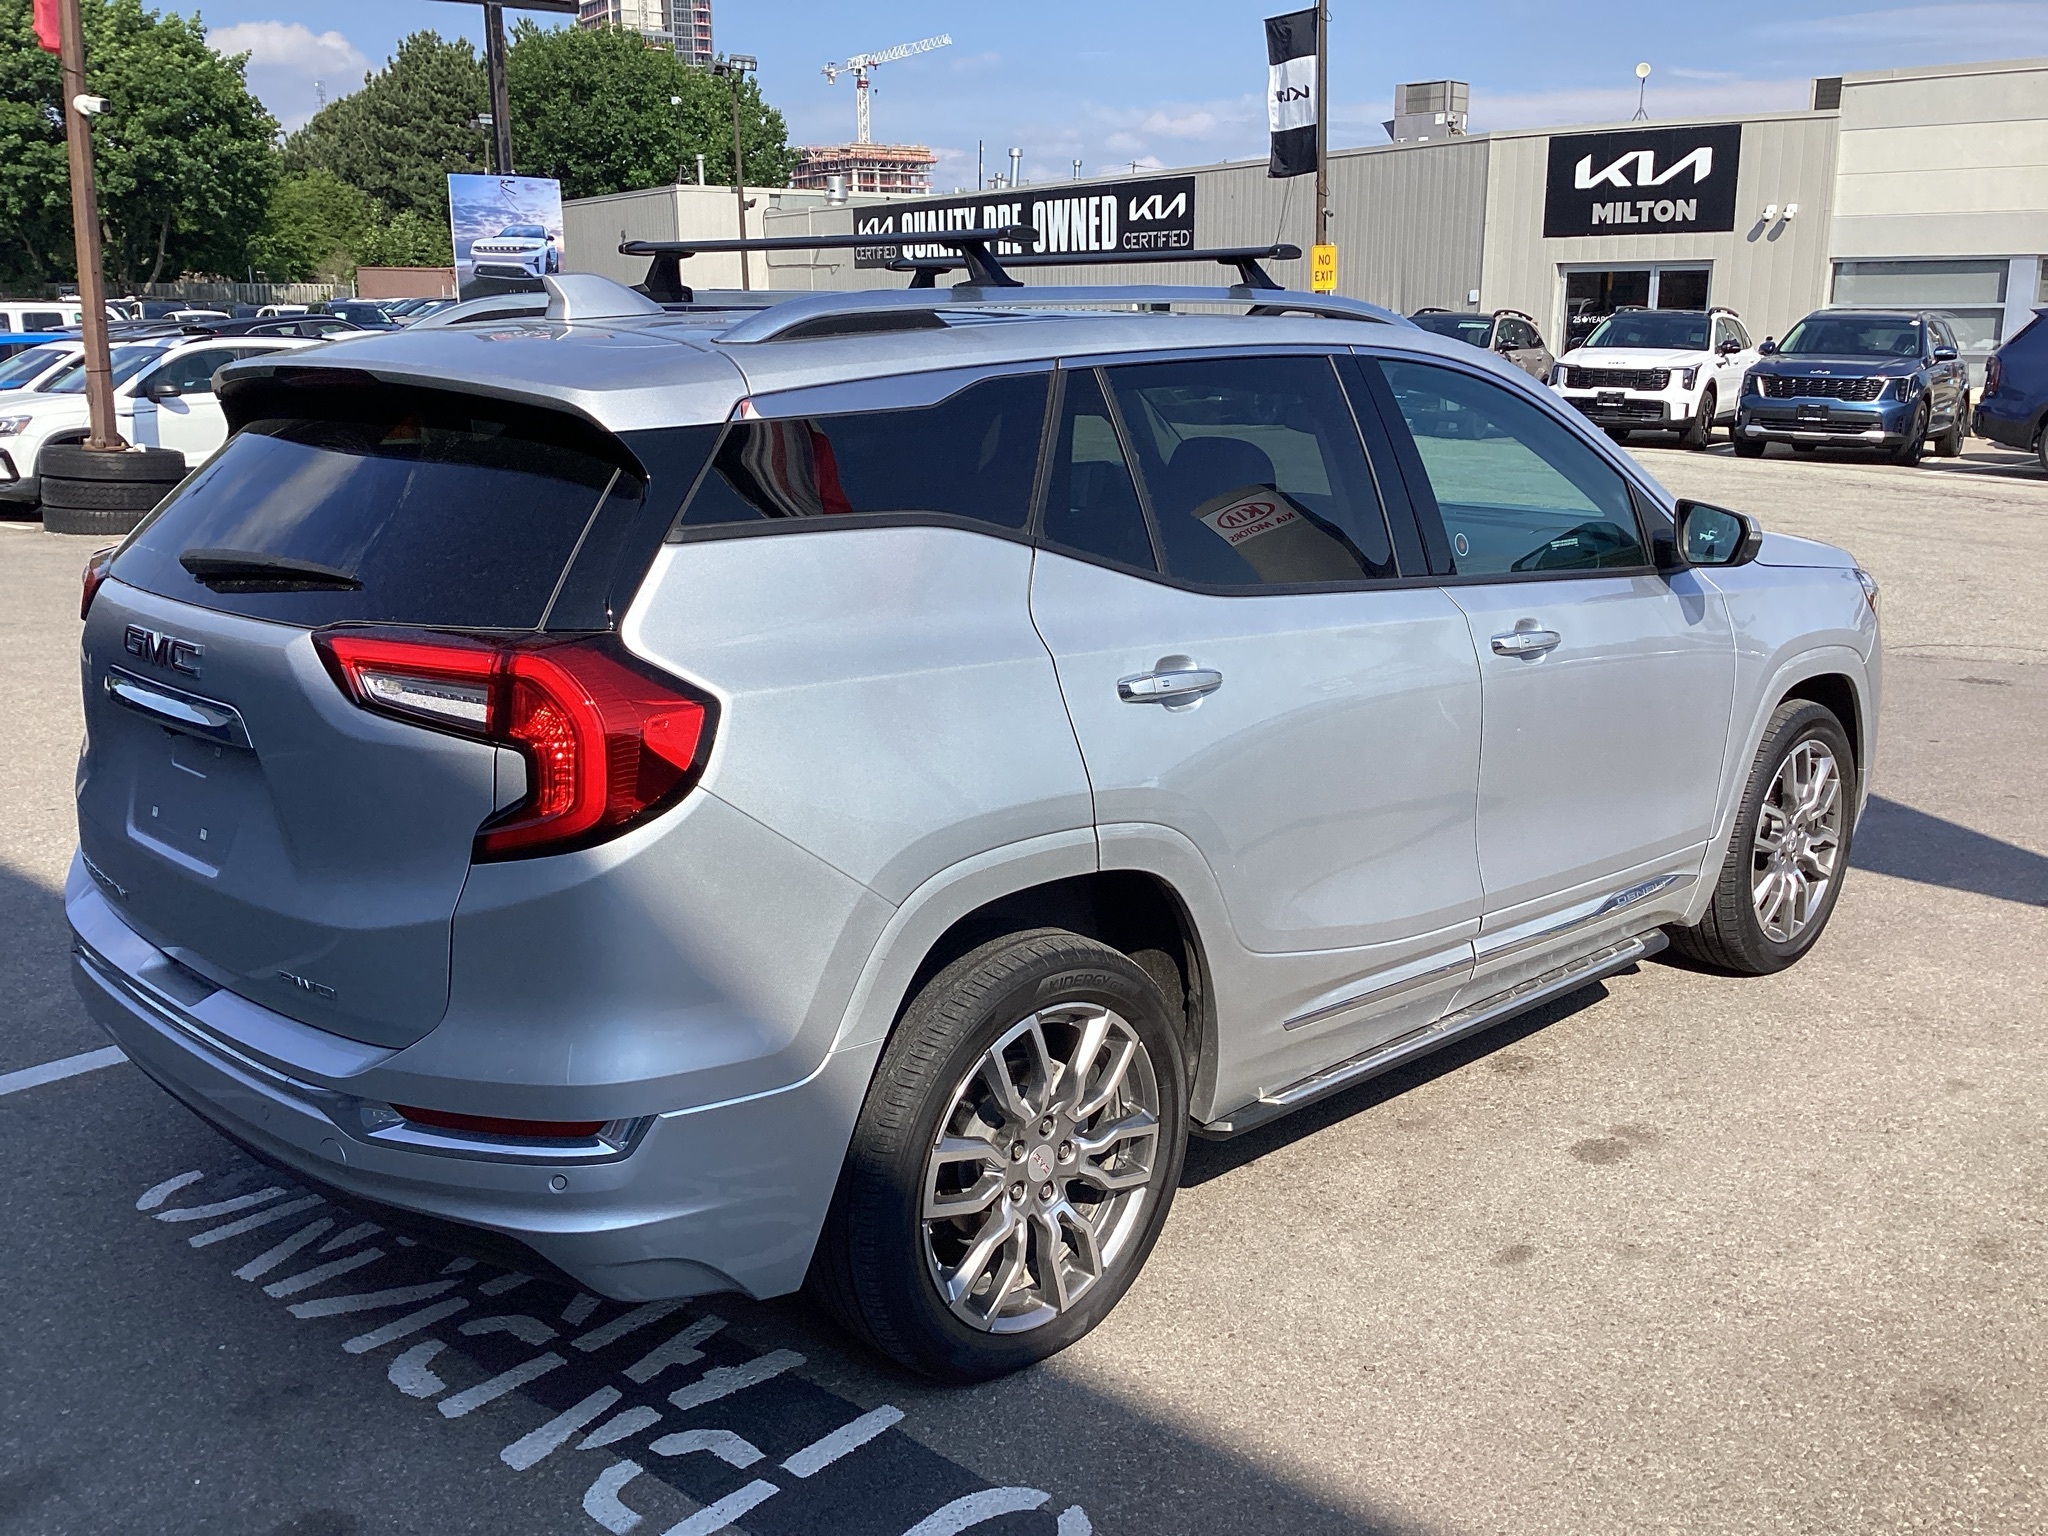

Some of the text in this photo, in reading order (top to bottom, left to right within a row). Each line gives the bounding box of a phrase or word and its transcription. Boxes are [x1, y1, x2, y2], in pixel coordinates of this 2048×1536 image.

[1574, 146, 1713, 190] KIA
[1129, 192, 1187, 222] KIA
[1591, 198, 1698, 225] MILTON
[901, 195, 1118, 260] QUALITY PRE OWNED
[1122, 229, 1190, 250] CERTIFIED
[855, 245, 897, 261] CERTIFIED
[1318, 254, 1331, 266] NO
[1315, 270, 1334, 282] EXIT
[1572, 315, 1609, 324] 25 YEAR
[124, 623, 206, 678] GMC
